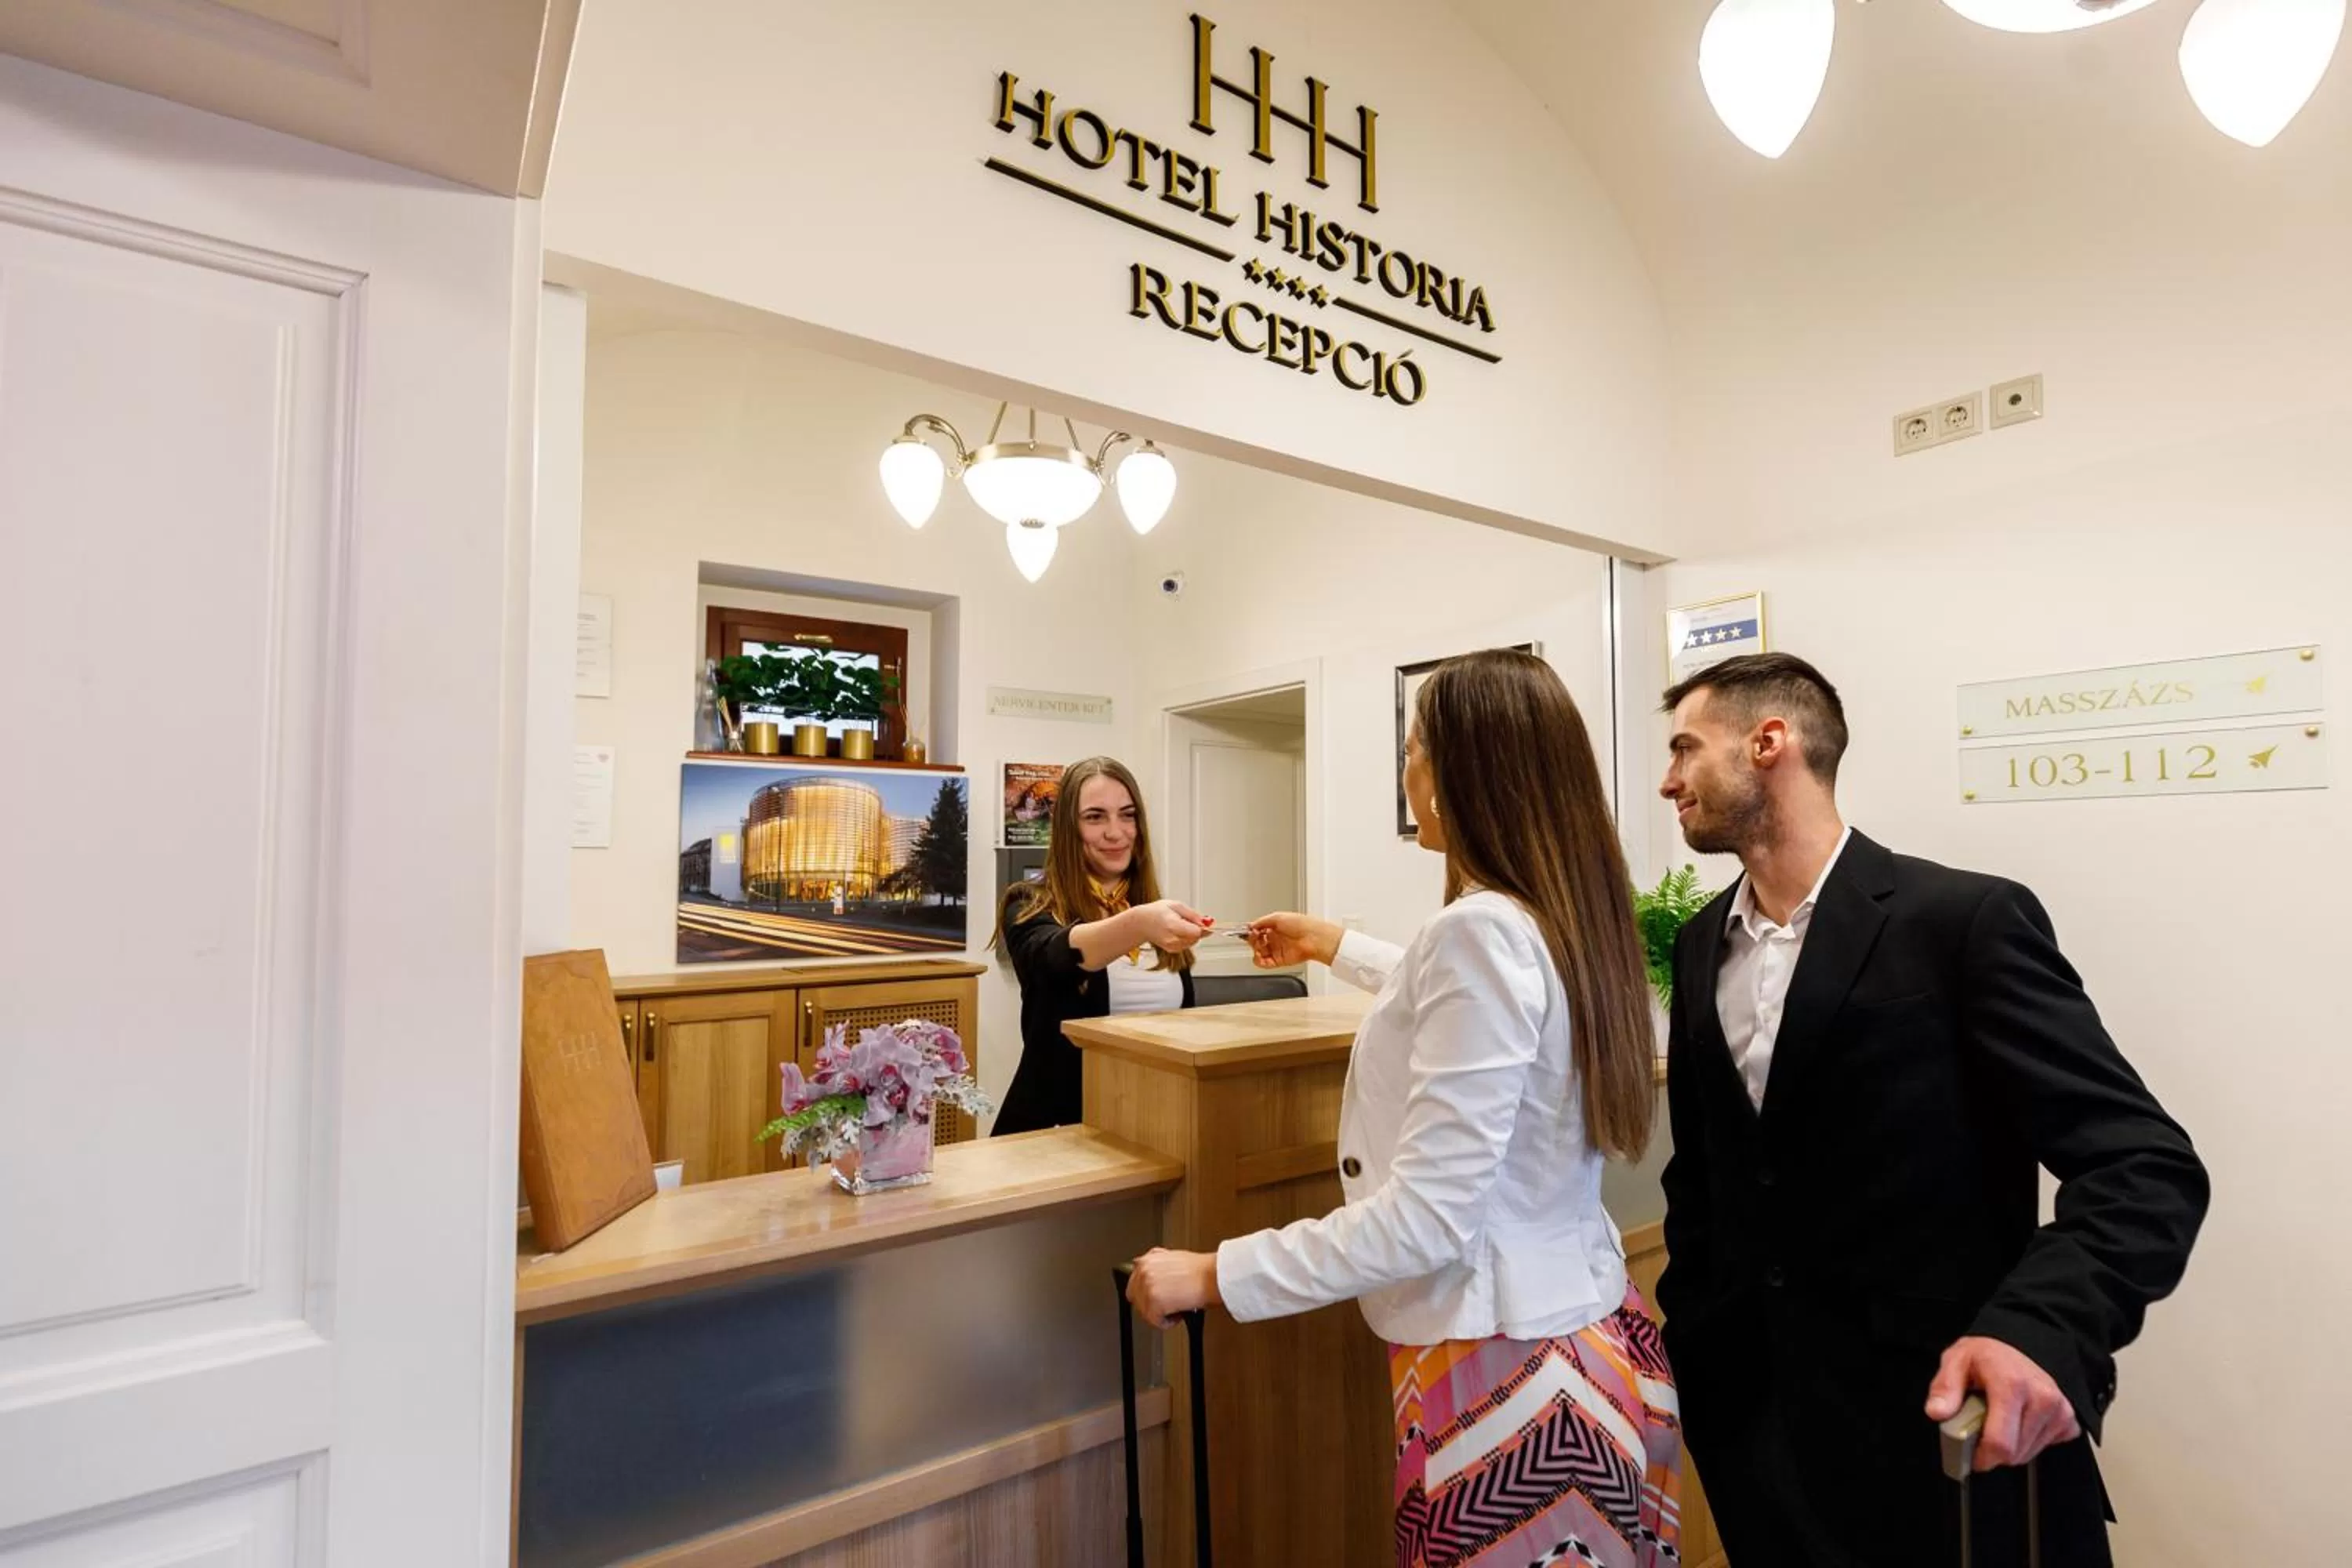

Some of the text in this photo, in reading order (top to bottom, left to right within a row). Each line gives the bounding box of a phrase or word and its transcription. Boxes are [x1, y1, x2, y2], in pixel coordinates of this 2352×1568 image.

[994, 71, 1497, 332] HOTEL HISTORIA
[1129, 263, 1427, 406] RECEPCIÓ
[2005, 681, 2194, 720] MASSZÁZS
[2006, 745, 2218, 789] 103-112
